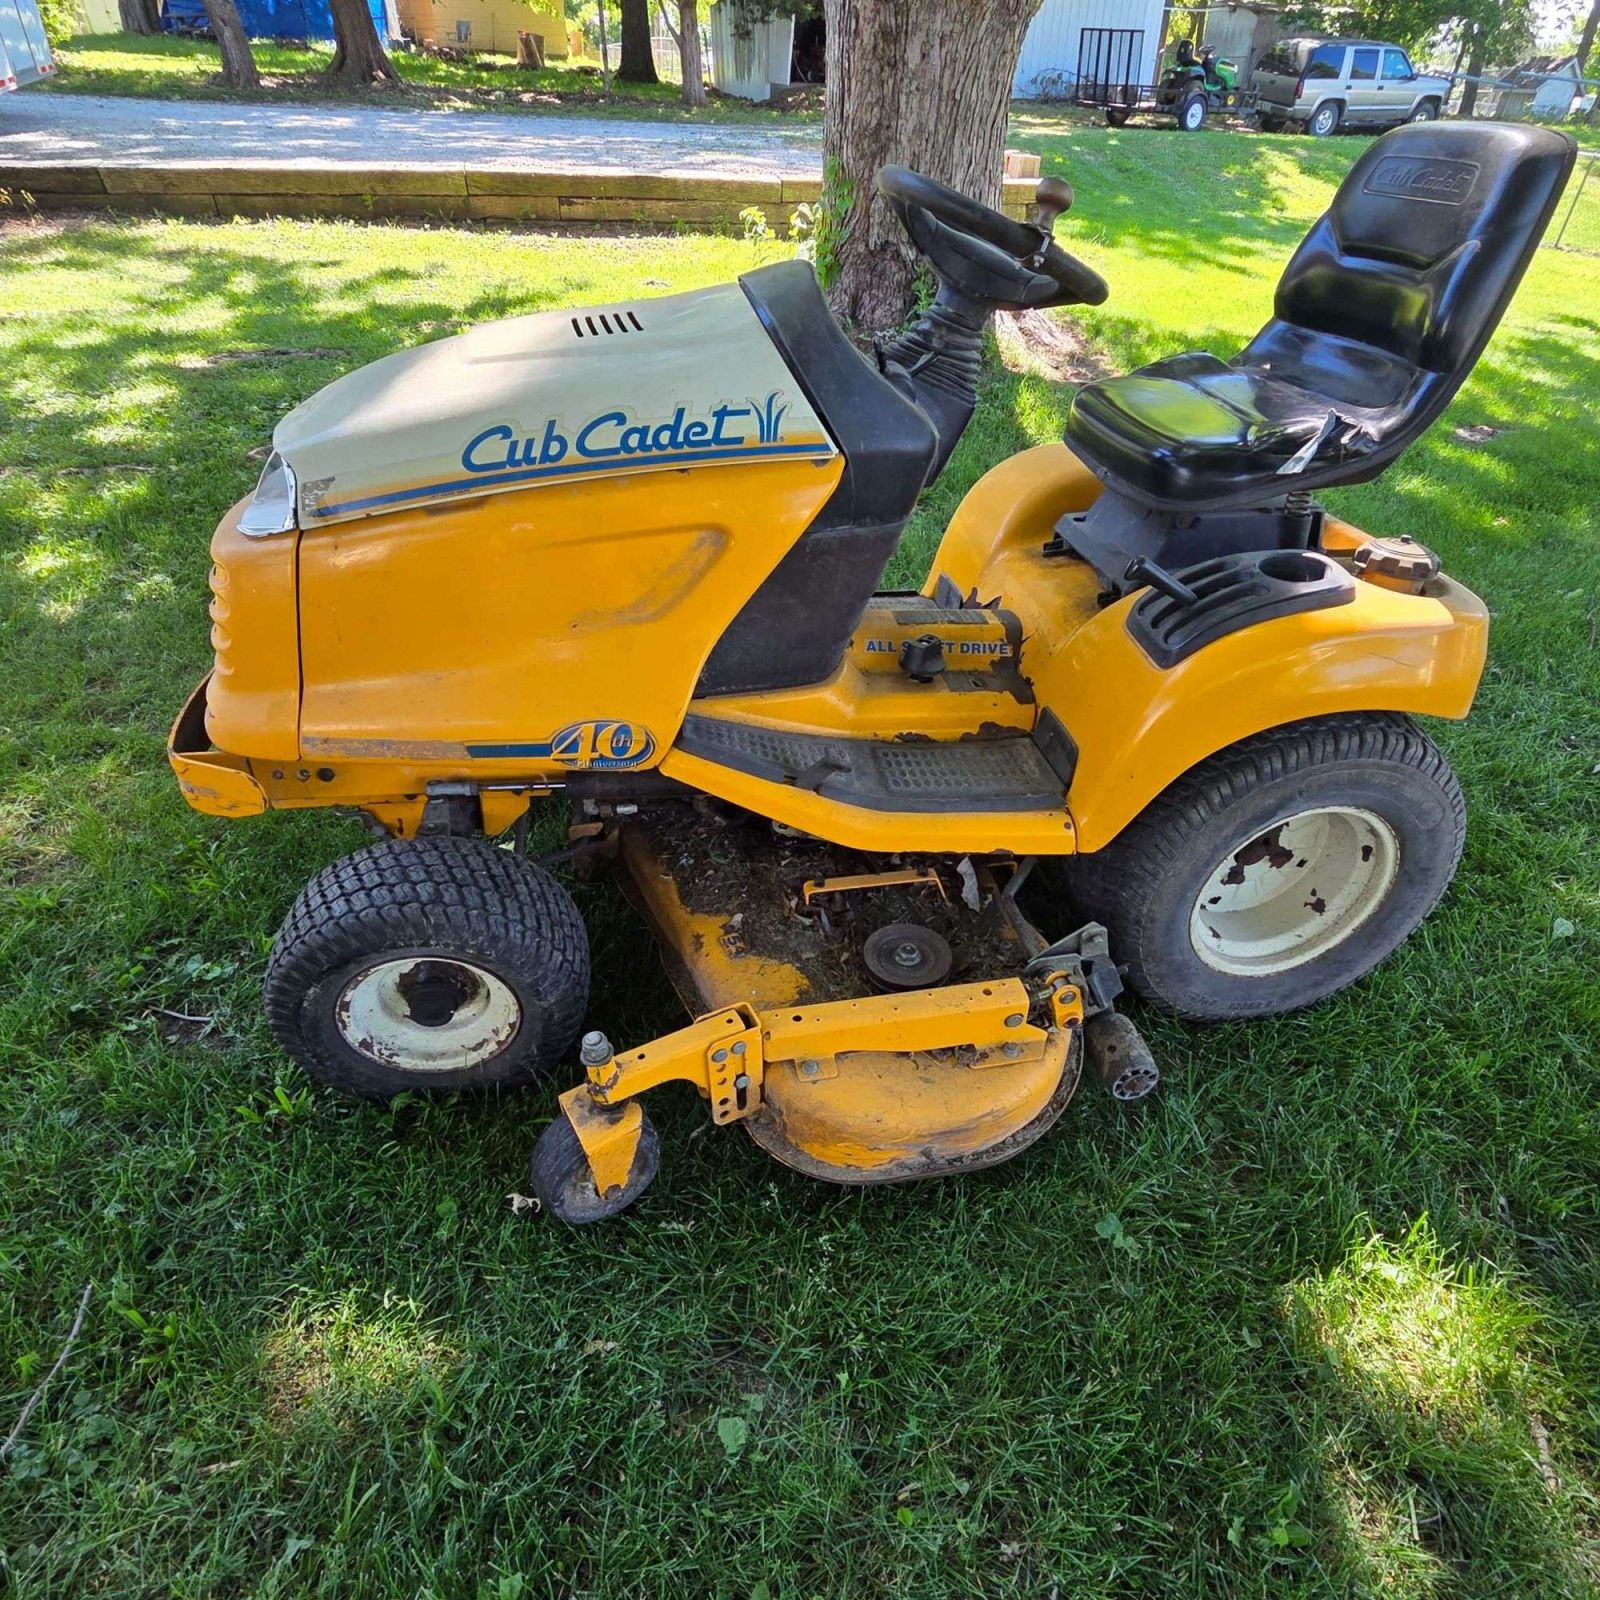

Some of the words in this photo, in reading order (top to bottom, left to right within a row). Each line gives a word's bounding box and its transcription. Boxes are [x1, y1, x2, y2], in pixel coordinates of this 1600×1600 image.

[1407, 168, 1472, 193] Cadet
[461, 419, 569, 473] Cub
[575, 404, 751, 458] Cadet
[866, 640, 897, 653] ALL
[959, 643, 1010, 655] DRIVE
